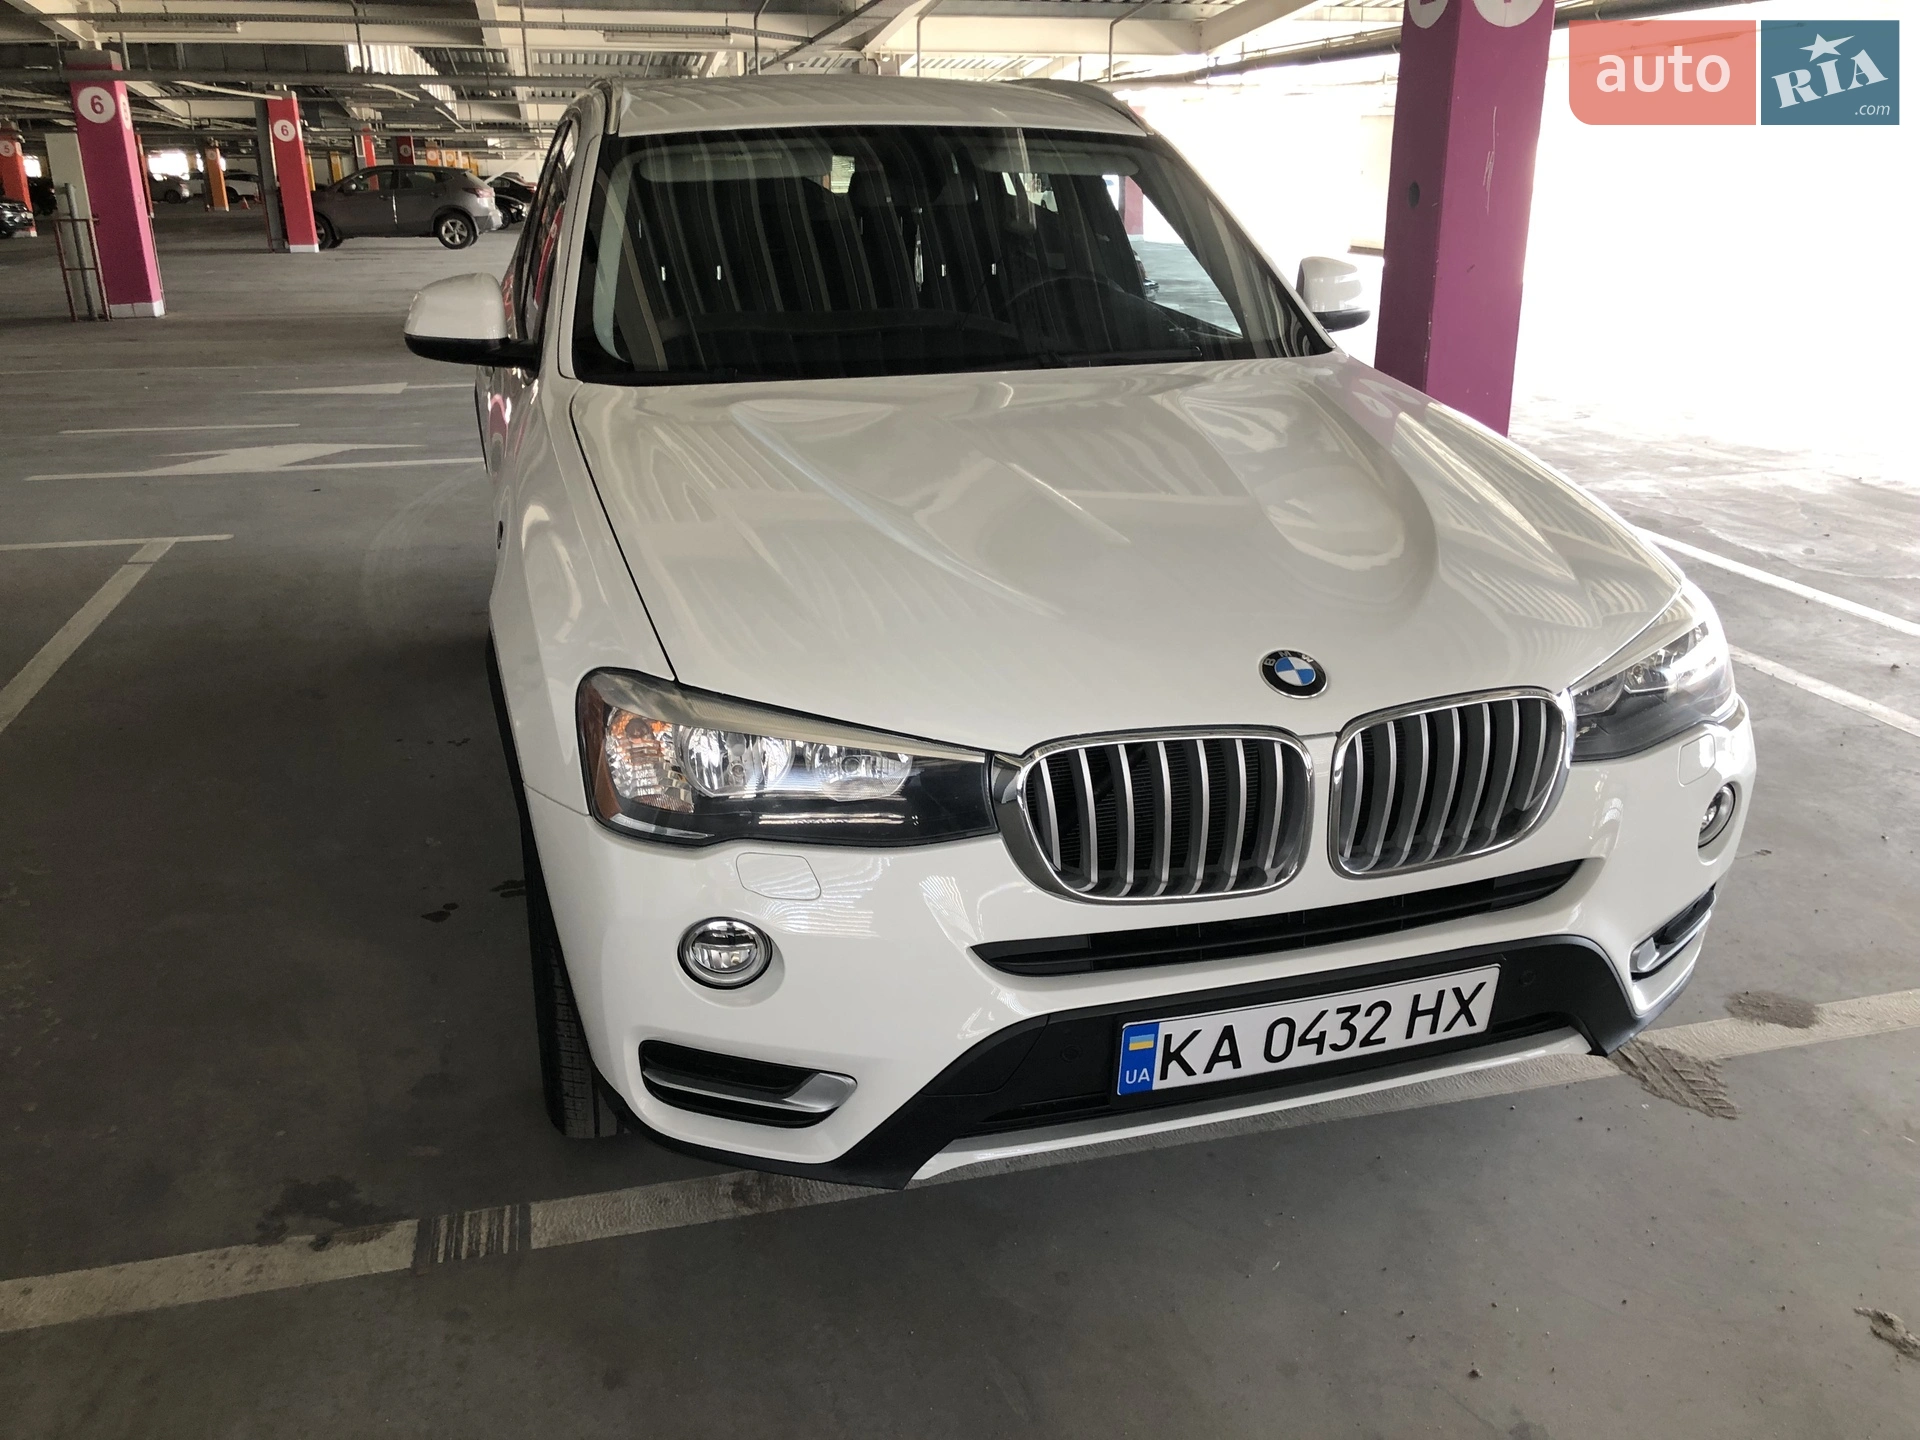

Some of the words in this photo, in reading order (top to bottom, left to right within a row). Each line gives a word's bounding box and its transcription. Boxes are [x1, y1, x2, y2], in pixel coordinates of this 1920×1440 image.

[90, 95, 105, 115] 6
[281, 125, 289, 136] 6
[1264, 650, 1314, 667] BMW
[1159, 1024, 1242, 1081] KA
[1263, 999, 1393, 1064] 0432
[1406, 981, 1488, 1040] HX
[1125, 1067, 1151, 1085] UA
